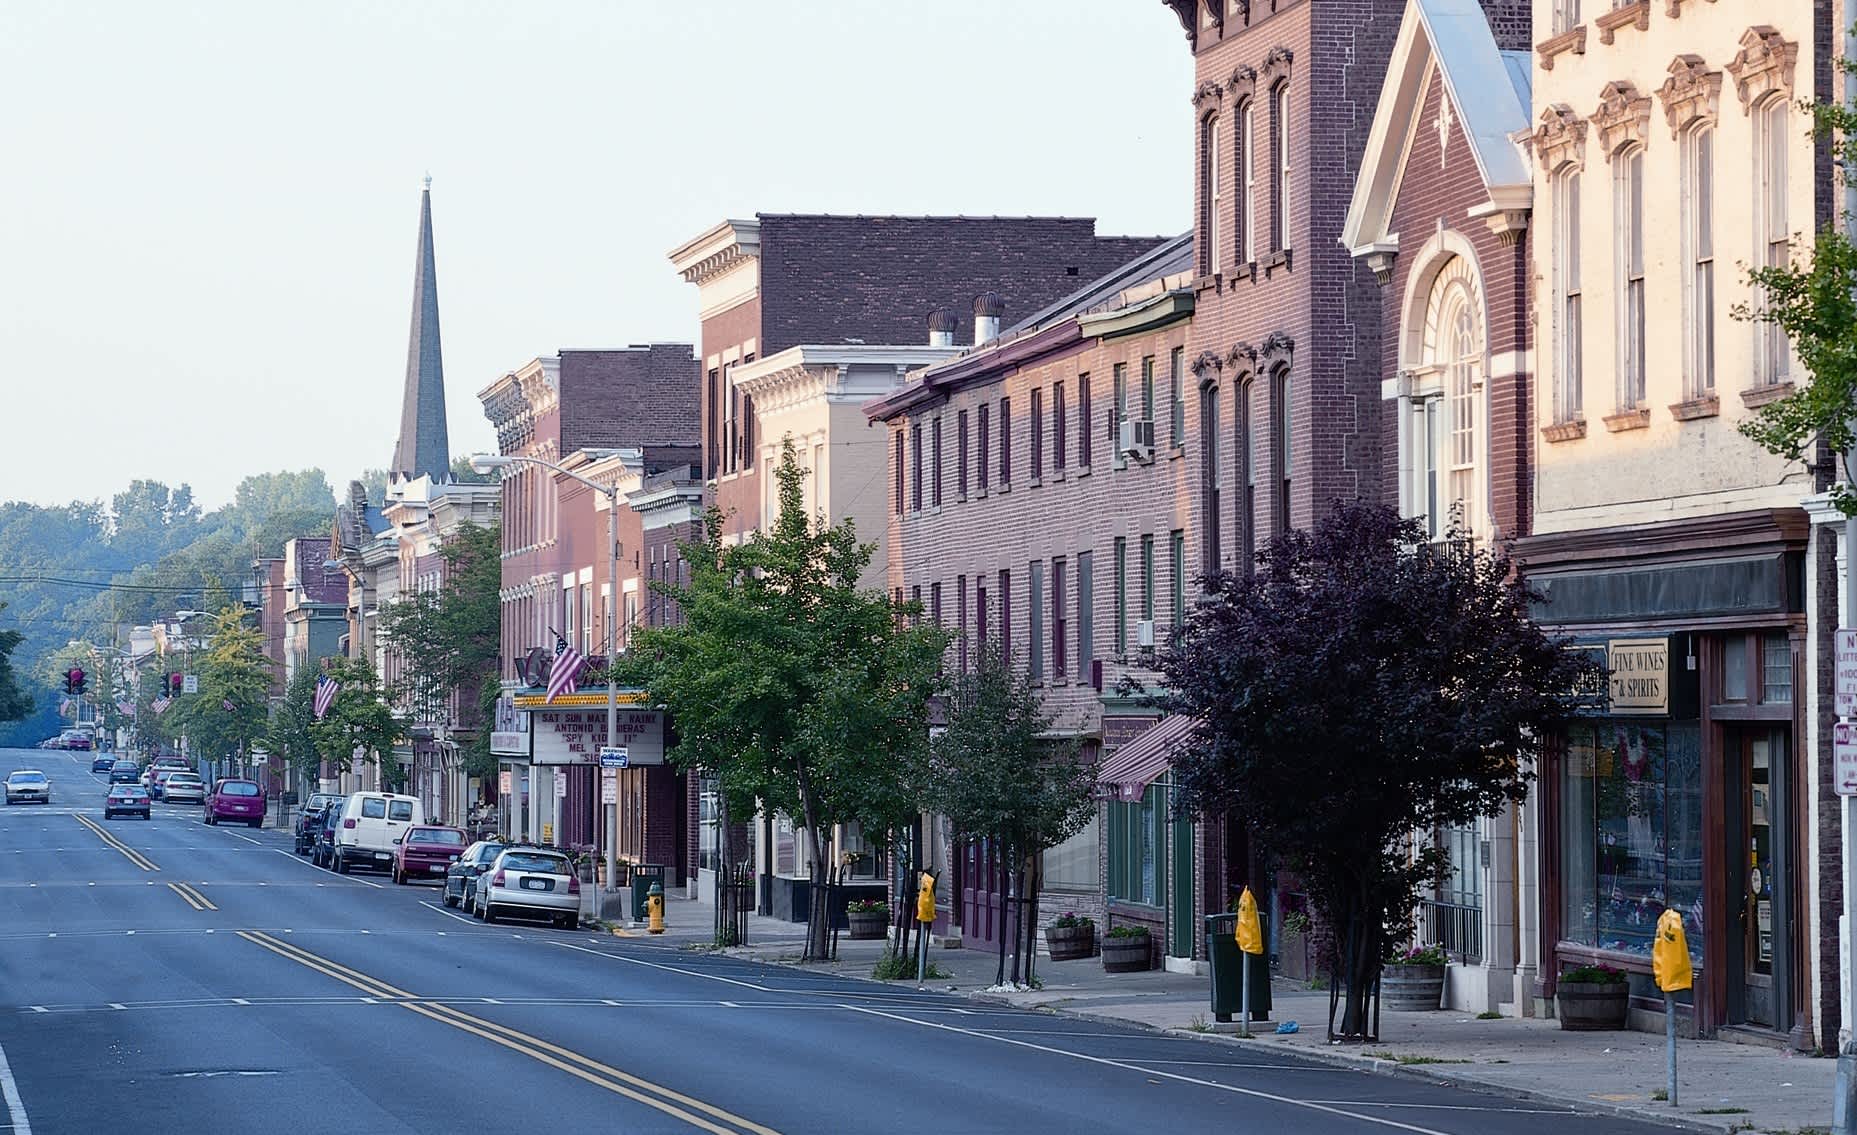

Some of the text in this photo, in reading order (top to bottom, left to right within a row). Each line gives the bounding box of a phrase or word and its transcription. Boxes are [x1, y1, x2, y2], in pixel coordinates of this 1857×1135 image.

[1614, 651, 1665, 672] FINE WINES
[1619, 678, 1660, 697] & SPIRITS
[542, 713, 559, 723] SAT
[565, 713, 582, 723] SUN
[555, 724, 594, 733] ANTONIO
[592, 733, 608, 743] KID
[1837, 727, 1848, 742] NO
[569, 743, 586, 753] MEL
